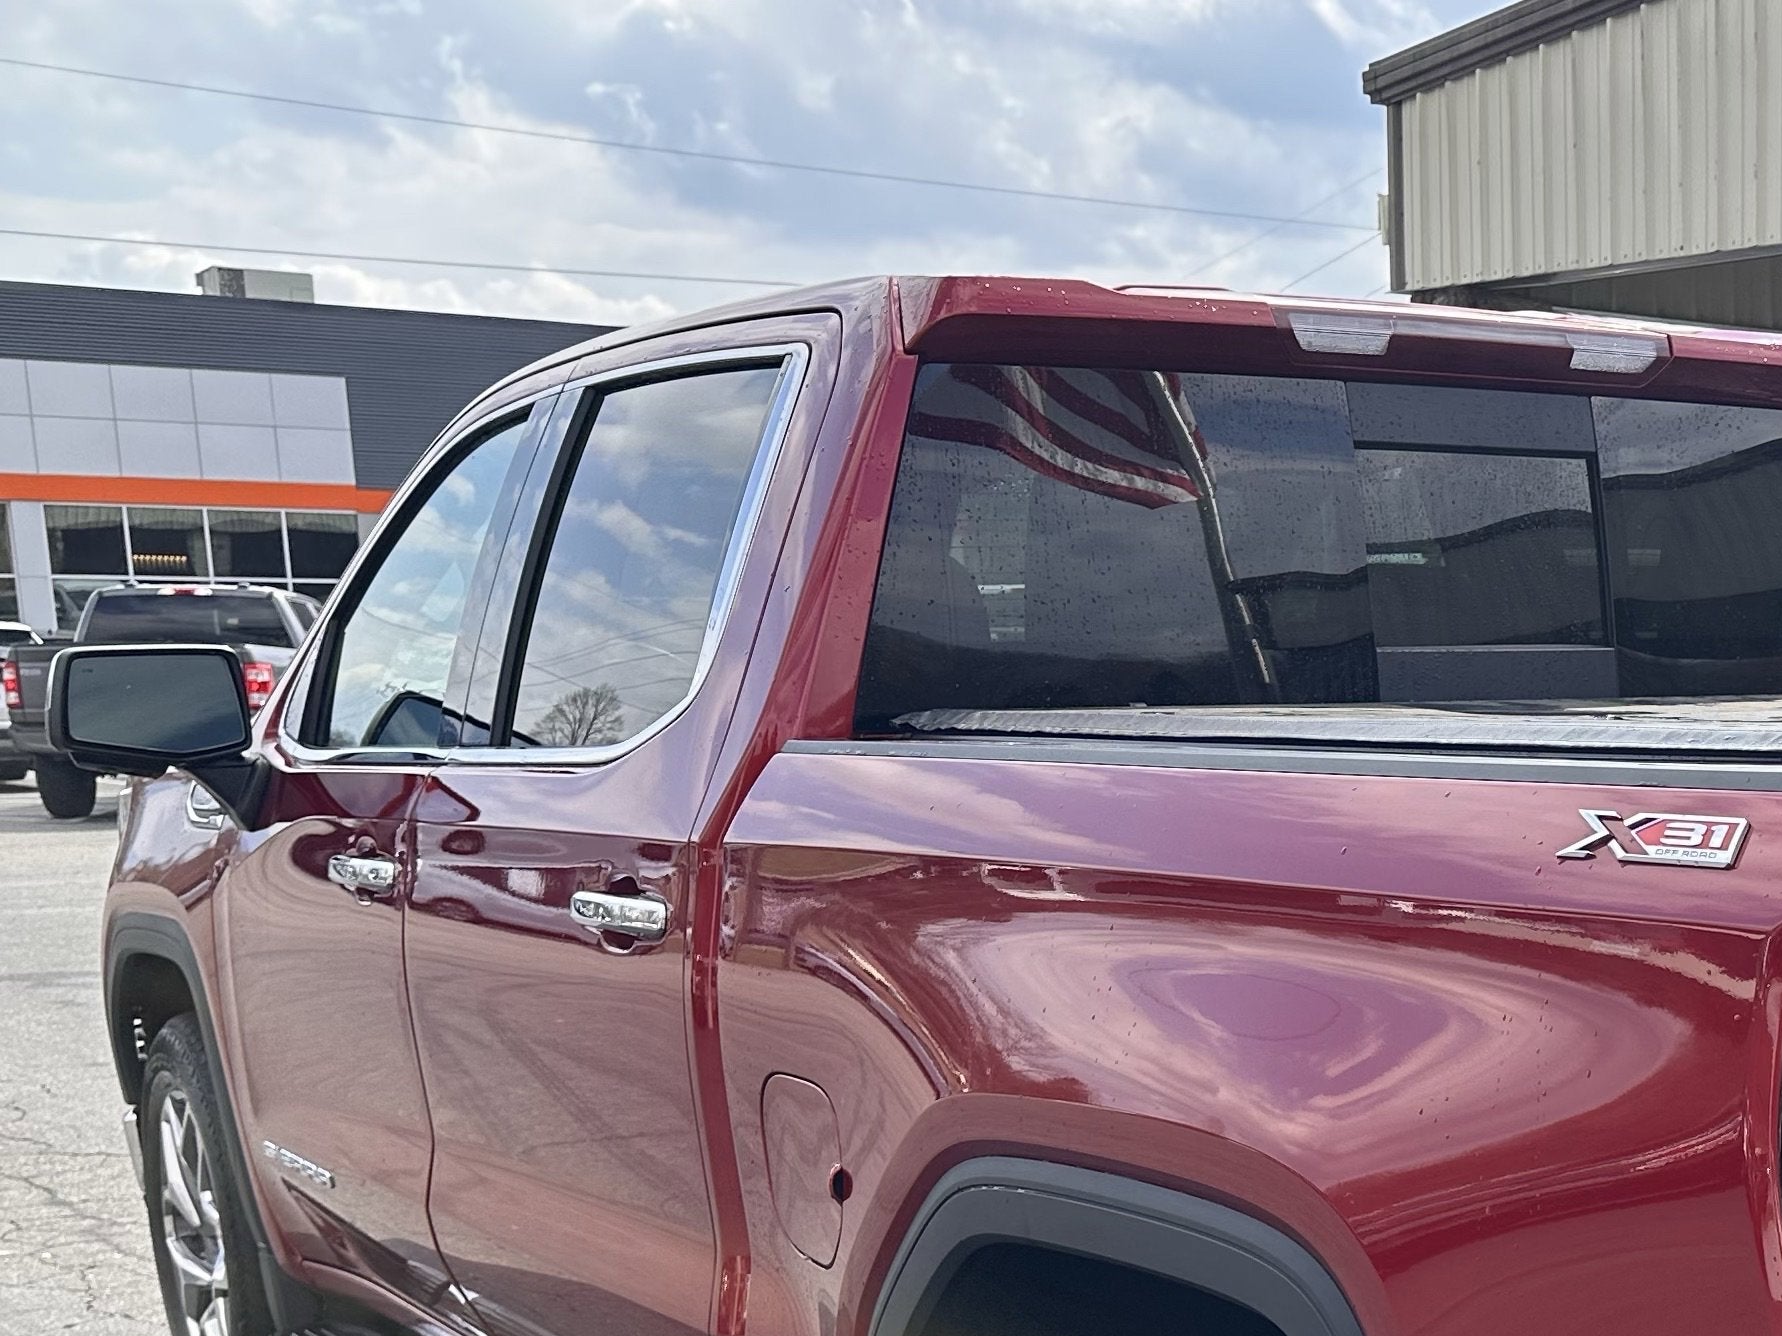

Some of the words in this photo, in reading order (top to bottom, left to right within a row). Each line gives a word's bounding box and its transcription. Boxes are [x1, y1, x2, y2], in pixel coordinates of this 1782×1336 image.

[1555, 808, 1731, 861] X31
[1654, 848, 1678, 857] OFF
[1681, 849, 1718, 859] ROAD
